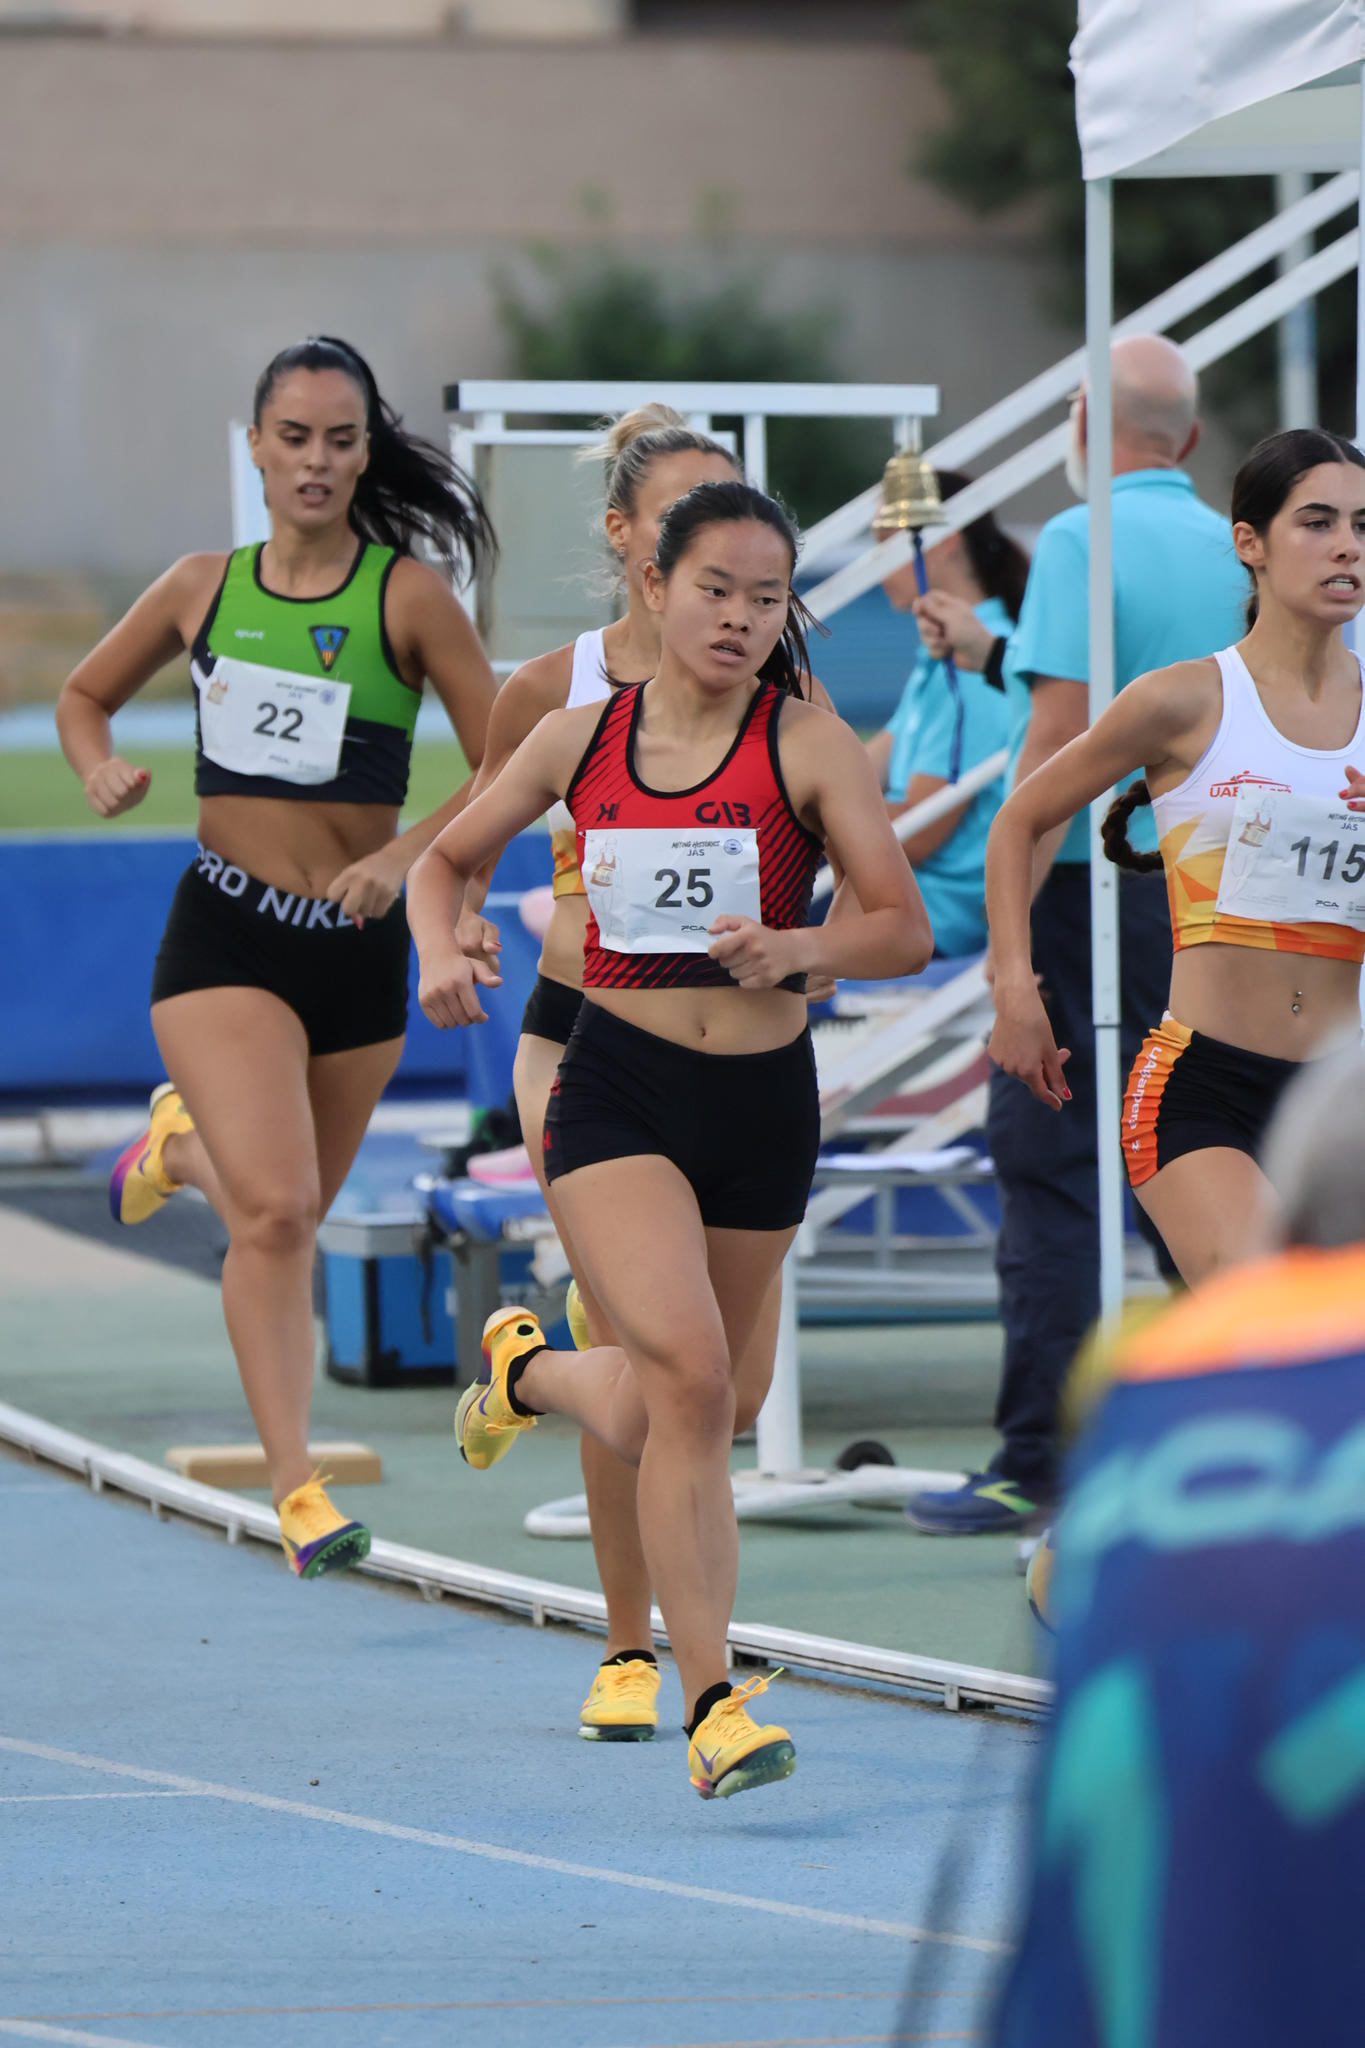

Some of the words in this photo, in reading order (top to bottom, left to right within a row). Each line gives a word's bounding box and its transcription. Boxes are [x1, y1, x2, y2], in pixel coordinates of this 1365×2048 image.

[253, 702, 304, 743] 22
[1341, 822, 1359, 831] JAS
[687, 849, 705, 857] JAS
[1290, 836, 1365, 884] 115
[654, 868, 714, 908] 25
